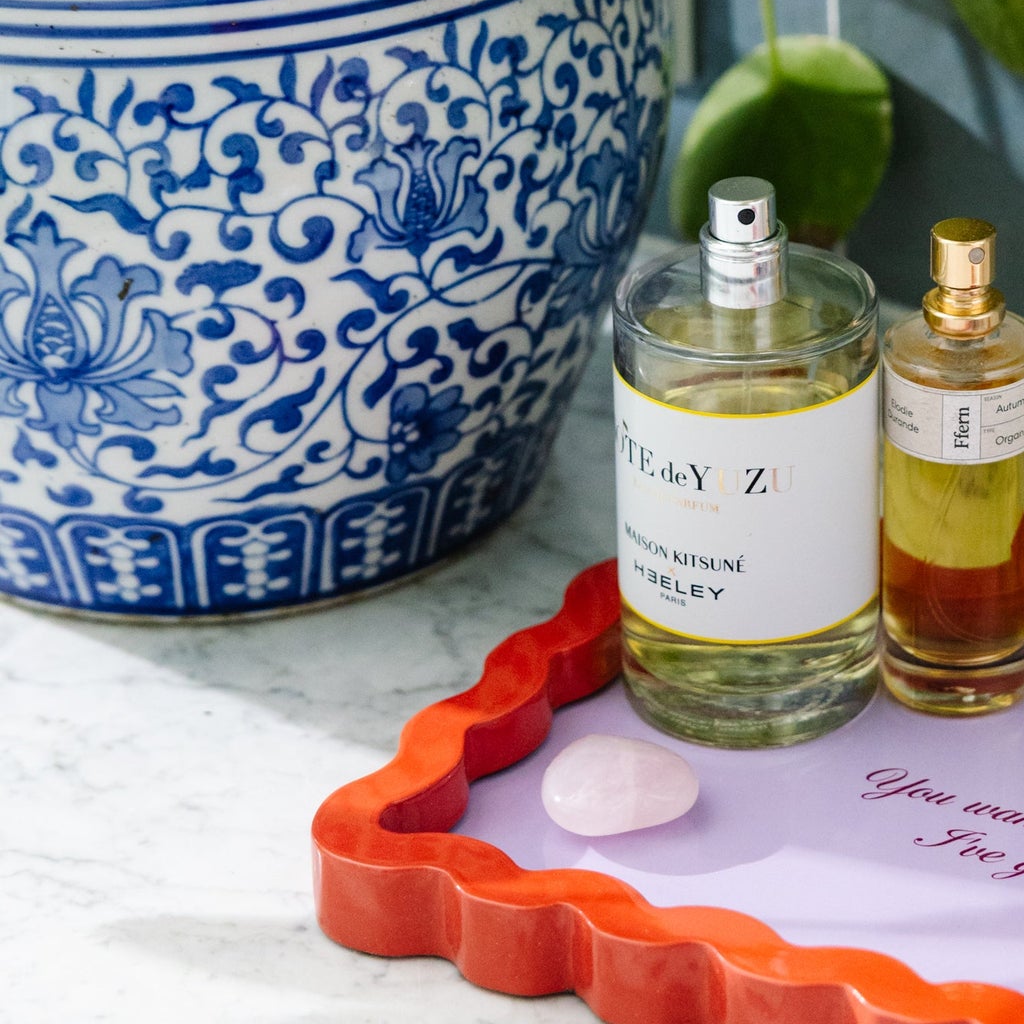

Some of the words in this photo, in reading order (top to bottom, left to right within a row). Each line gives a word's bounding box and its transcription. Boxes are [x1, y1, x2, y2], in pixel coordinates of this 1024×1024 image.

[954, 406, 970, 449] Ffern
[660, 461, 687, 487] de
[687, 462, 796, 495] YUZU
[624, 521, 668, 560] MAISON
[673, 550, 746, 573] KITSUNÉ
[659, 591, 687, 607] PARIS
[861, 767, 956, 805] You
[914, 828, 1006, 864] I've
